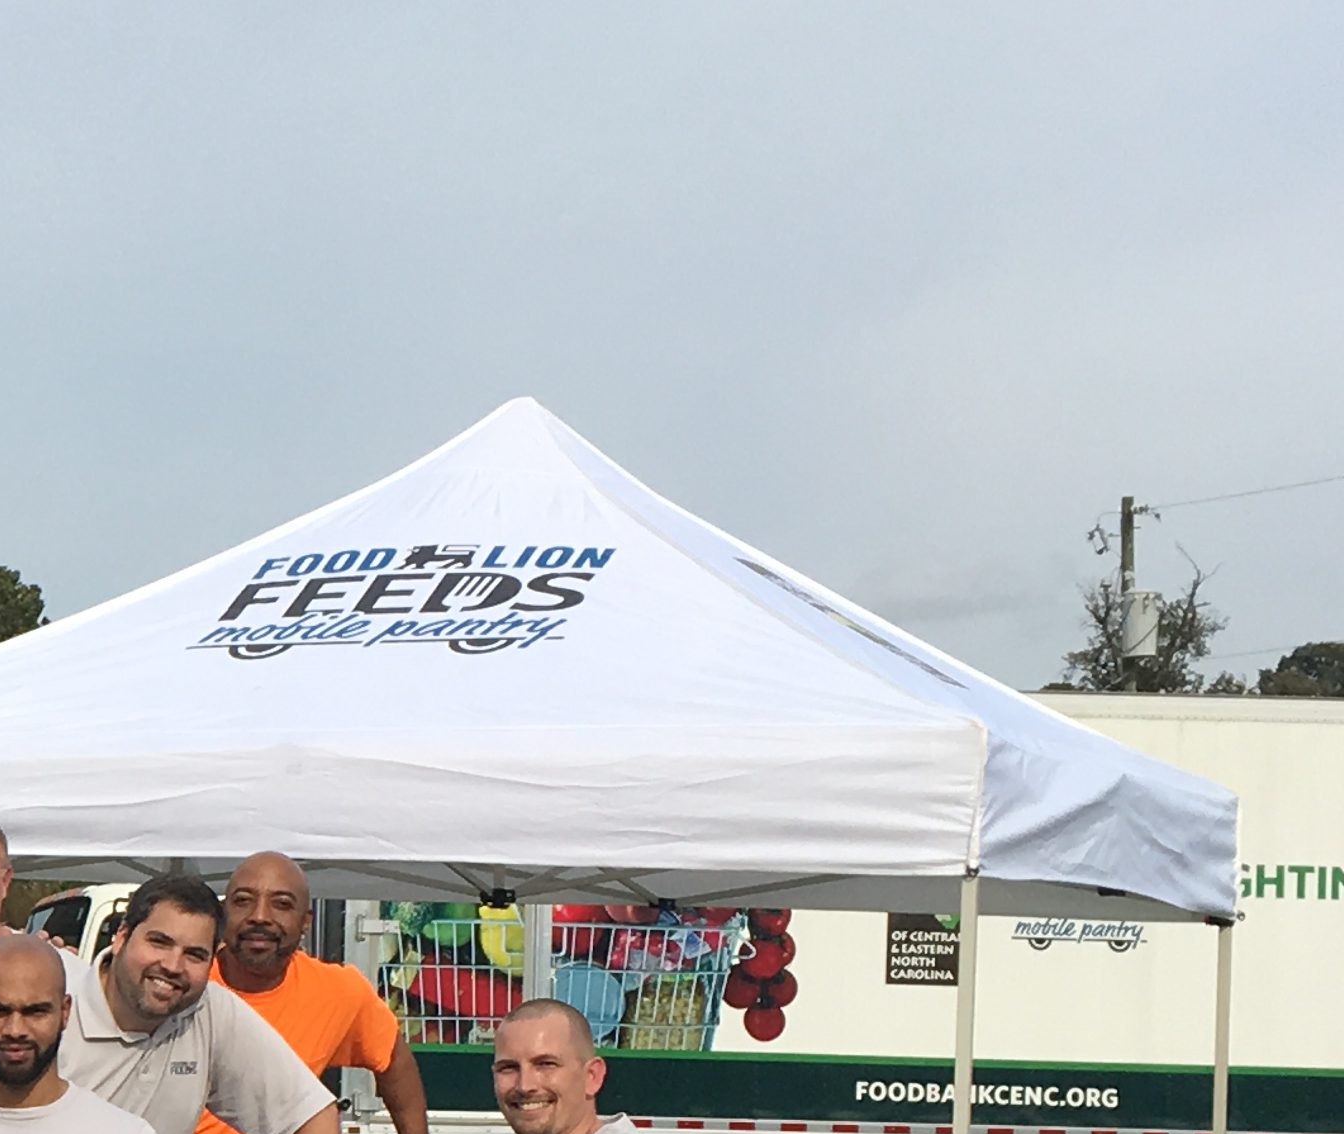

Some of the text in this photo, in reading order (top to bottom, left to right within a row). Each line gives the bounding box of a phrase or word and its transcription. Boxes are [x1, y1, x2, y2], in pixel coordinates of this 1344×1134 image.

[252, 545, 617, 580] FOOD LION
[218, 572, 596, 621] FEEDS
[199, 611, 568, 649] mobile pantry
[891, 930, 909, 942] OF
[1014, 917, 1144, 949] mobile pantry
[890, 943, 955, 955] & EASTERN
[890, 956, 936, 968] NORTH
[889, 968, 955, 981] CAROLINA
[855, 1081, 1120, 1109] FOODBAKCENC.ORG
